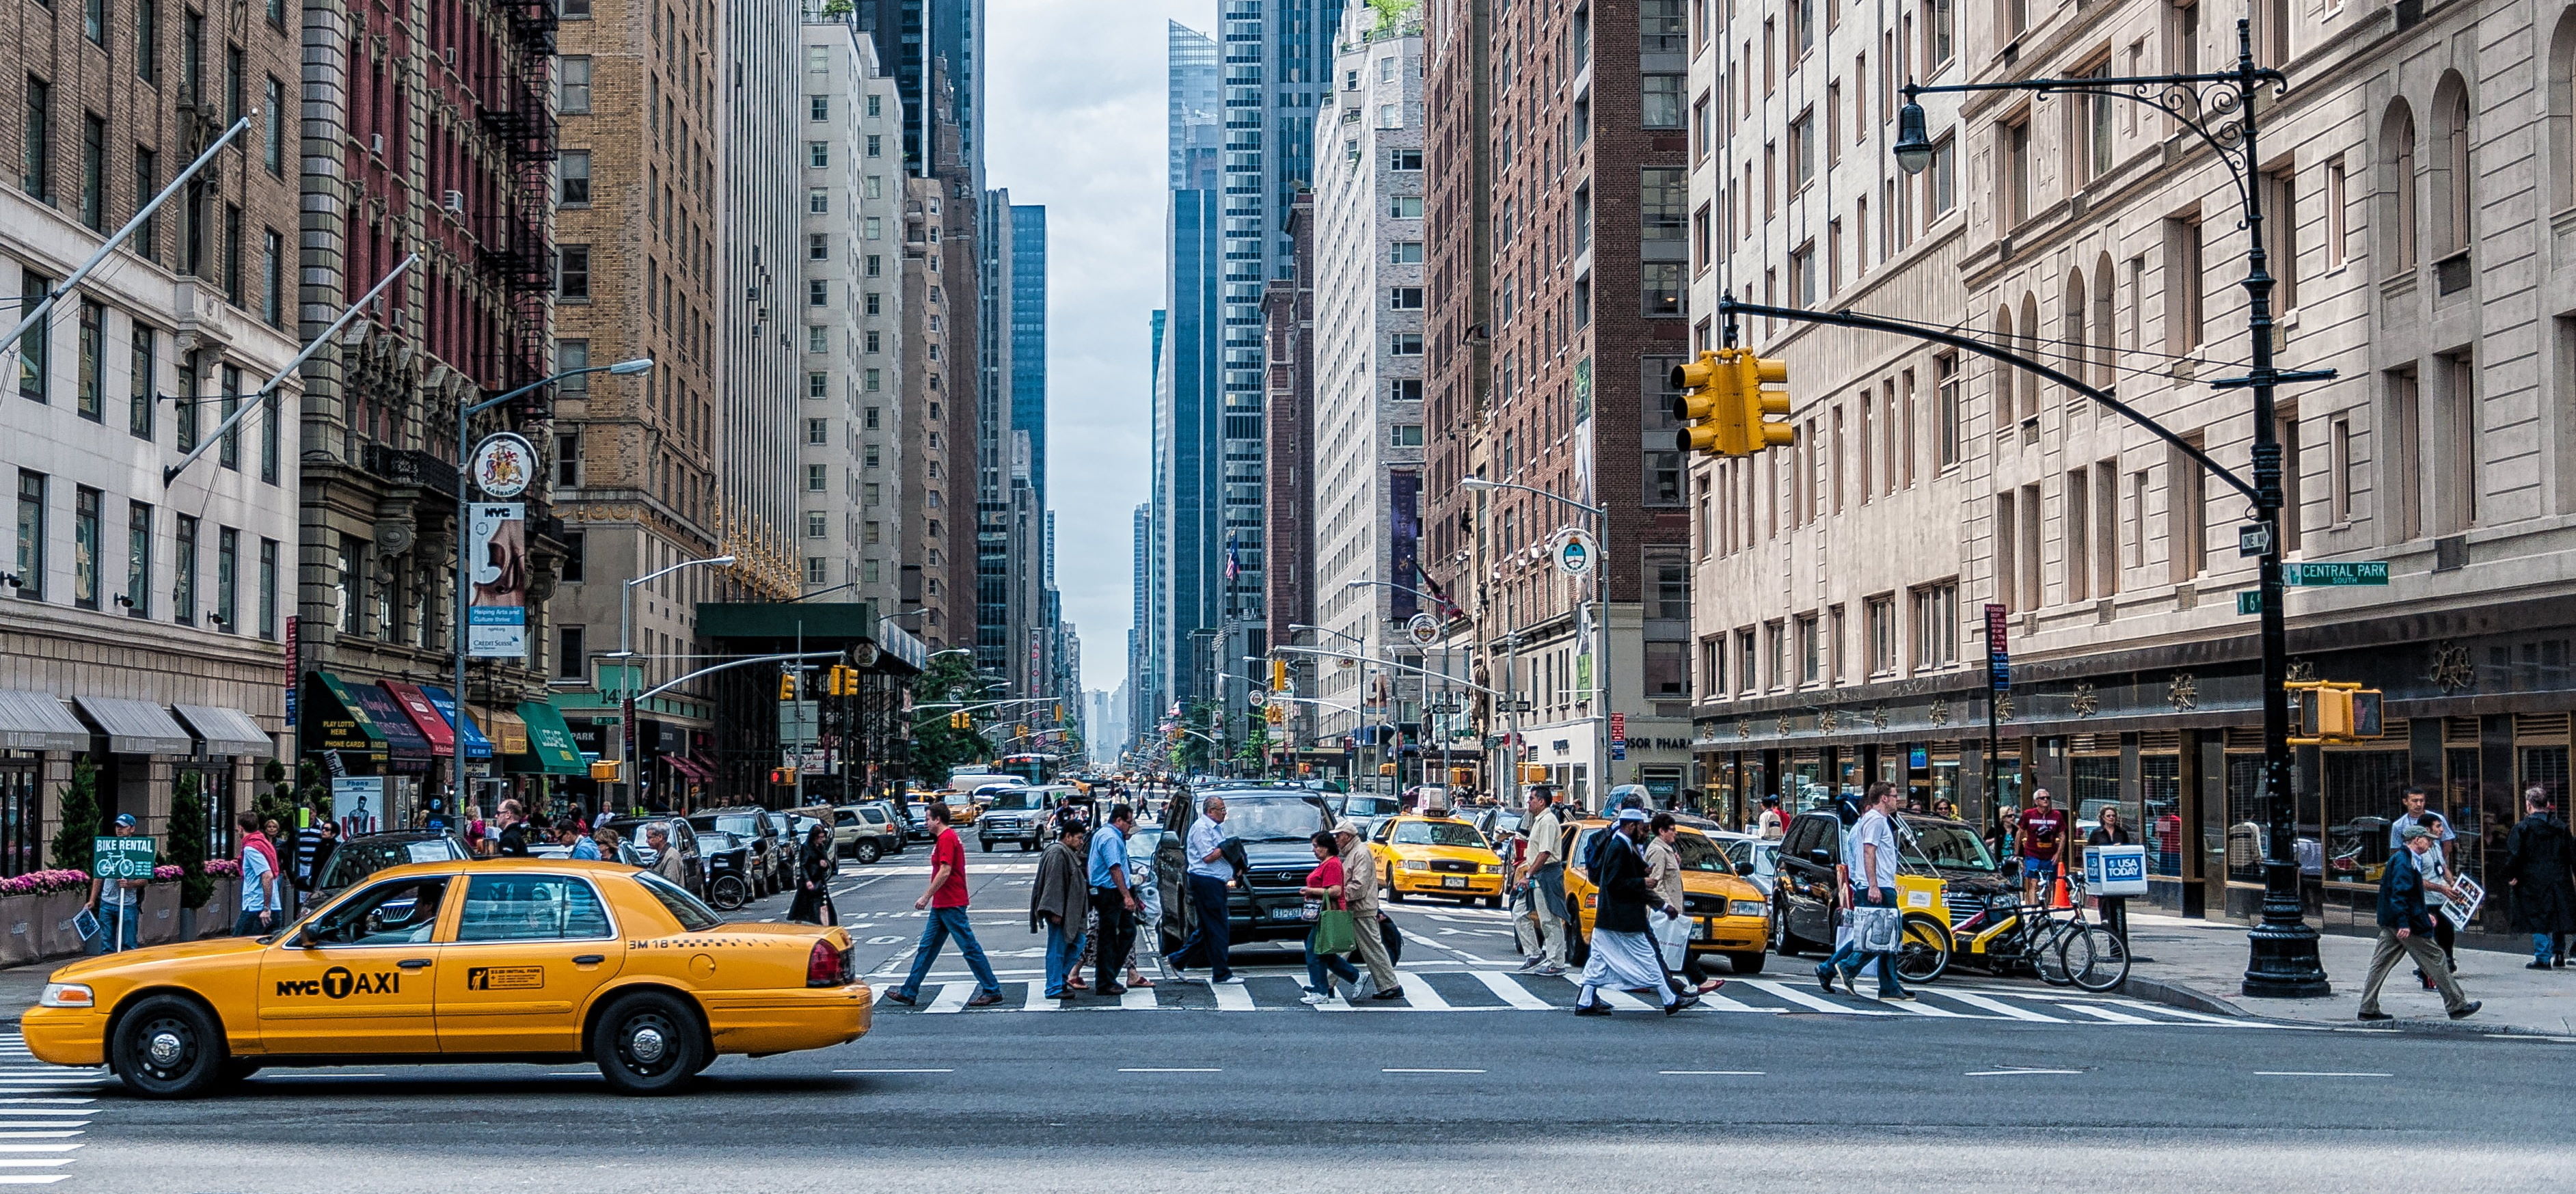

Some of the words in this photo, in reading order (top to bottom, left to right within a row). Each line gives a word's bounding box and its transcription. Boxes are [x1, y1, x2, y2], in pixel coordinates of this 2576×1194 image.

[486, 486, 521, 496] BARBADOS
[485, 508, 511, 517] NYC
[2244, 535, 2254, 547] ONE
[2303, 565, 2353, 577] CENTRAL
[2358, 565, 2386, 576] PARK
[2249, 594, 2255, 610] 6
[433, 799, 441, 809] P
[96, 840, 117, 852] BIKE
[119, 840, 152, 853] RENTAL
[2118, 858, 2138, 867] USA
[2107, 867, 2139, 876] TODAY
[629, 940, 648, 949] 3M
[654, 940, 668, 949] 18
[276, 980, 321, 996] NYC
[325, 969, 400, 996] TAXI
